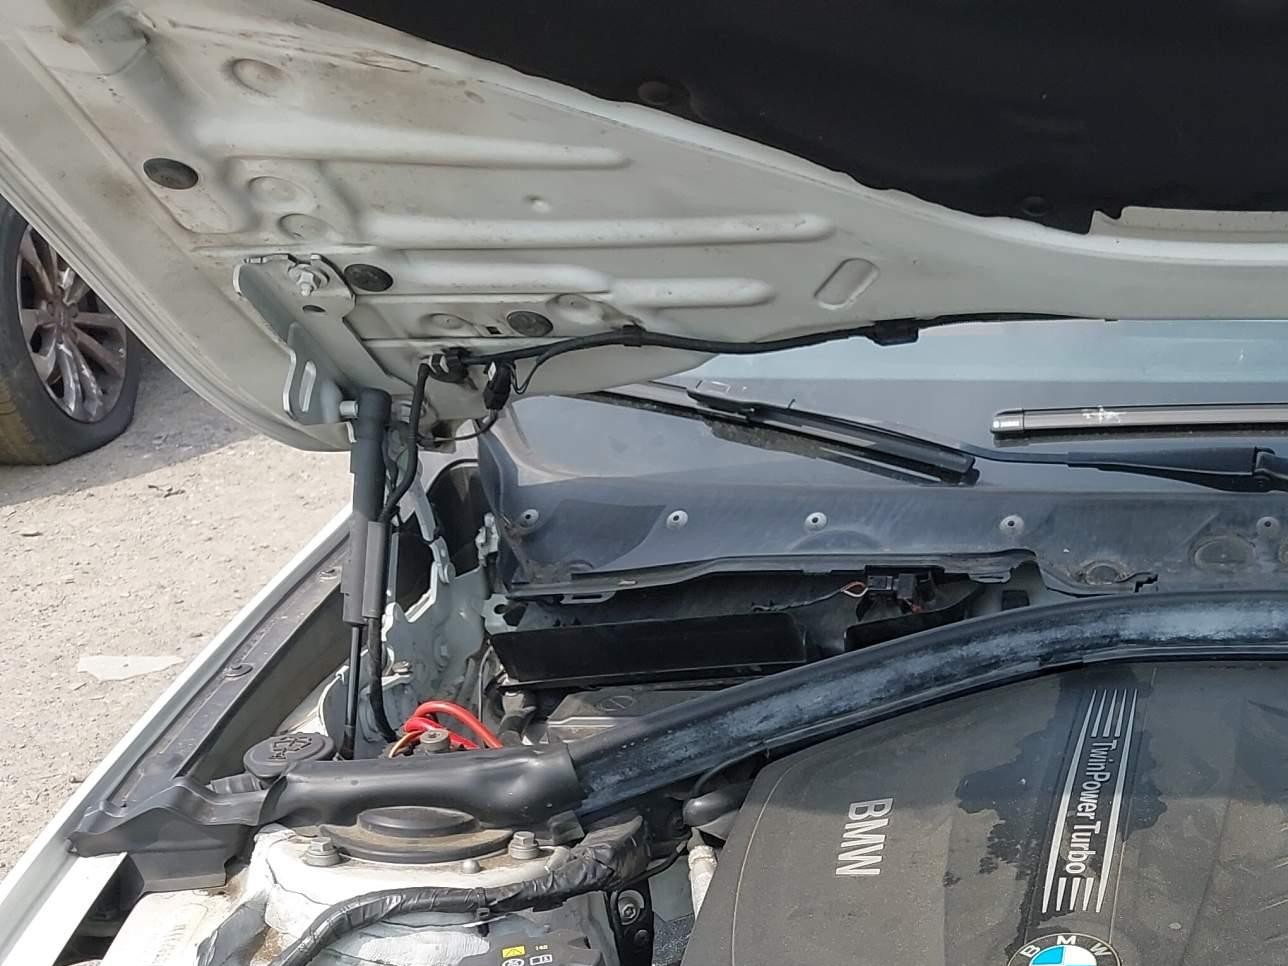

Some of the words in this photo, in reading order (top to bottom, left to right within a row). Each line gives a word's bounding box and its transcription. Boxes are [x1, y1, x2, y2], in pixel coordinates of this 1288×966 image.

[1076, 739, 1118, 819] TwinPower
[835, 797, 894, 875] BMW
[1065, 821, 1101, 875] Turbo
[1019, 935, 1112, 958] BMW
